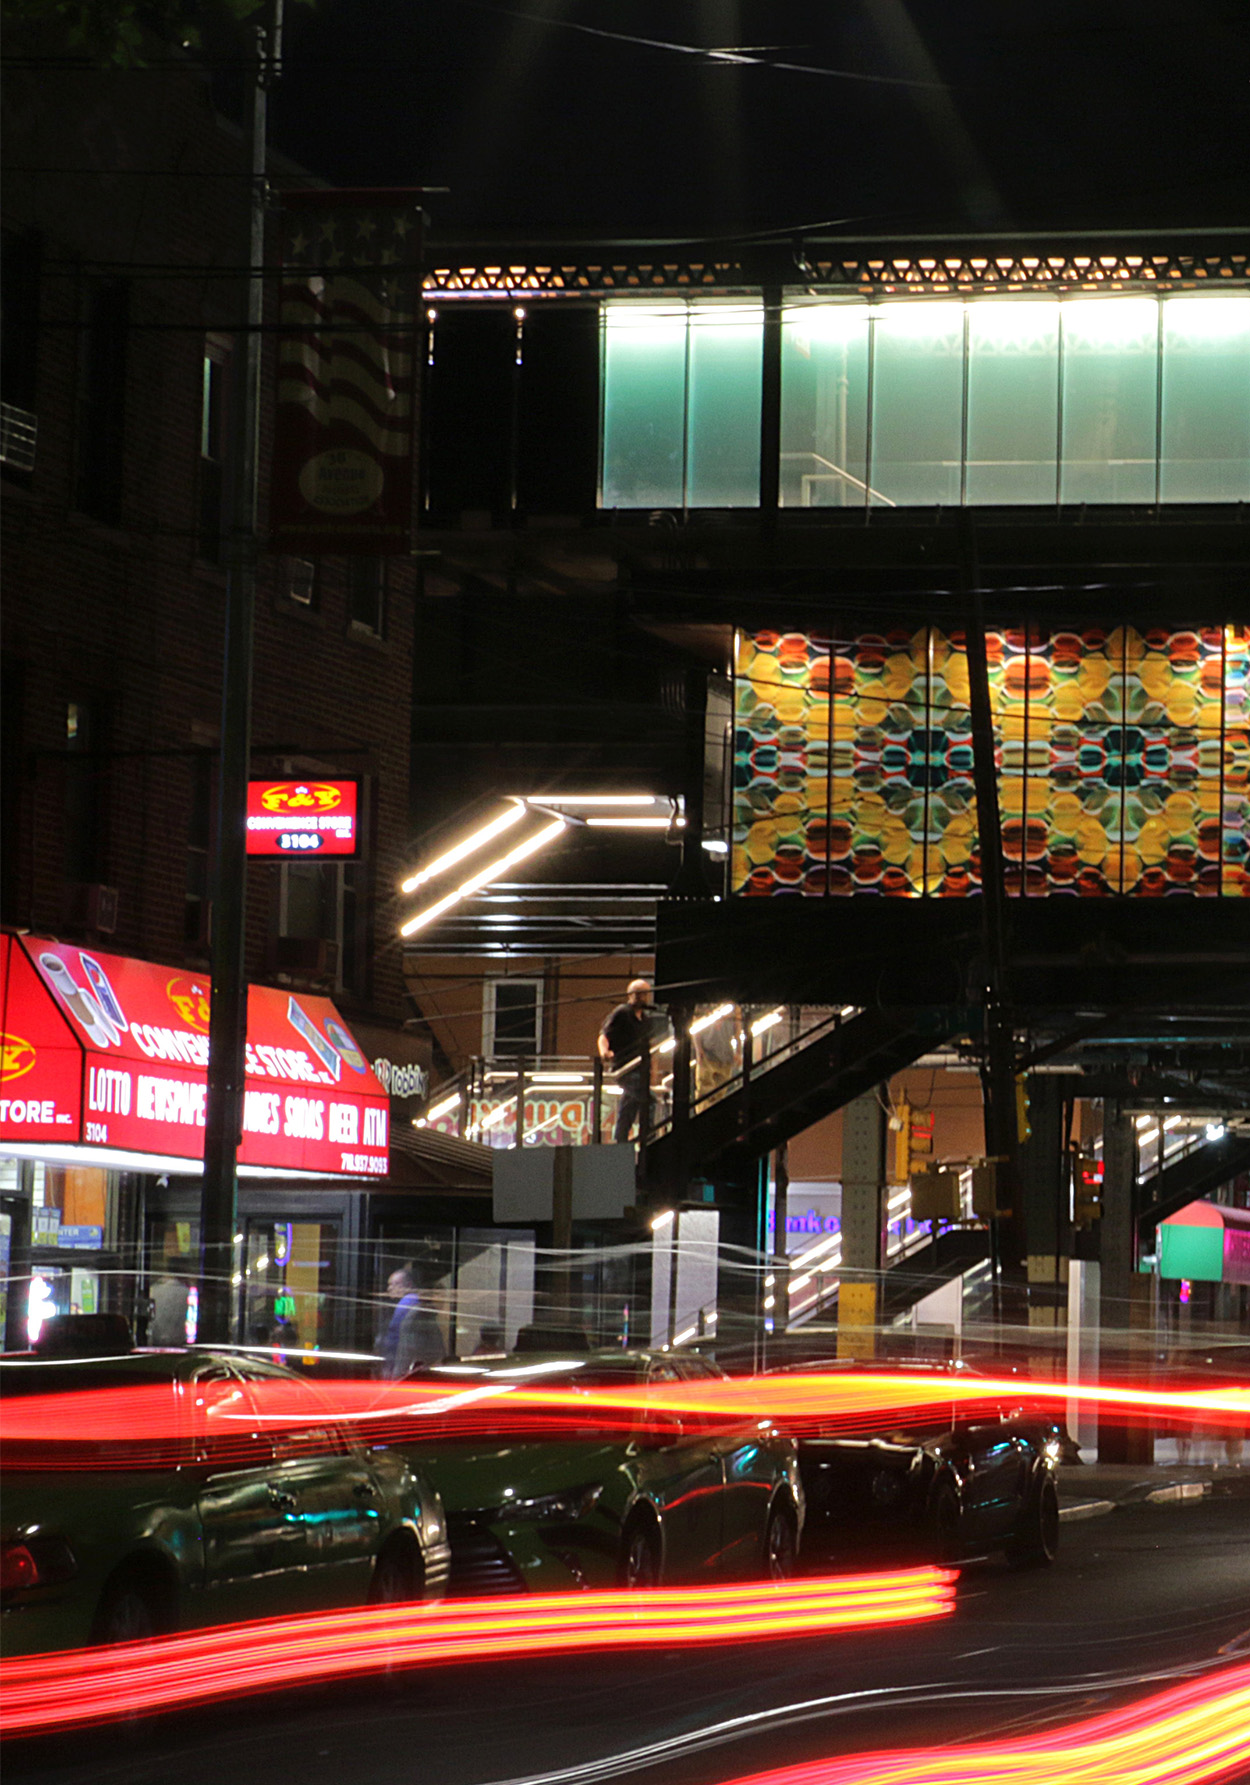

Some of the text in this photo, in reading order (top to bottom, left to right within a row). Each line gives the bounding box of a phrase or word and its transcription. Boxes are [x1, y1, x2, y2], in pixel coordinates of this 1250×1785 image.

[281, 834, 319, 849] 3104
[255, 1045, 319, 1082] STORE
[89, 1067, 131, 1116] LOTTO
[283, 1096, 325, 1141] SODAS
[329, 1102, 359, 1144] BEER
[363, 1107, 387, 1147] ATM
[86, 1122, 108, 1143] 3104
